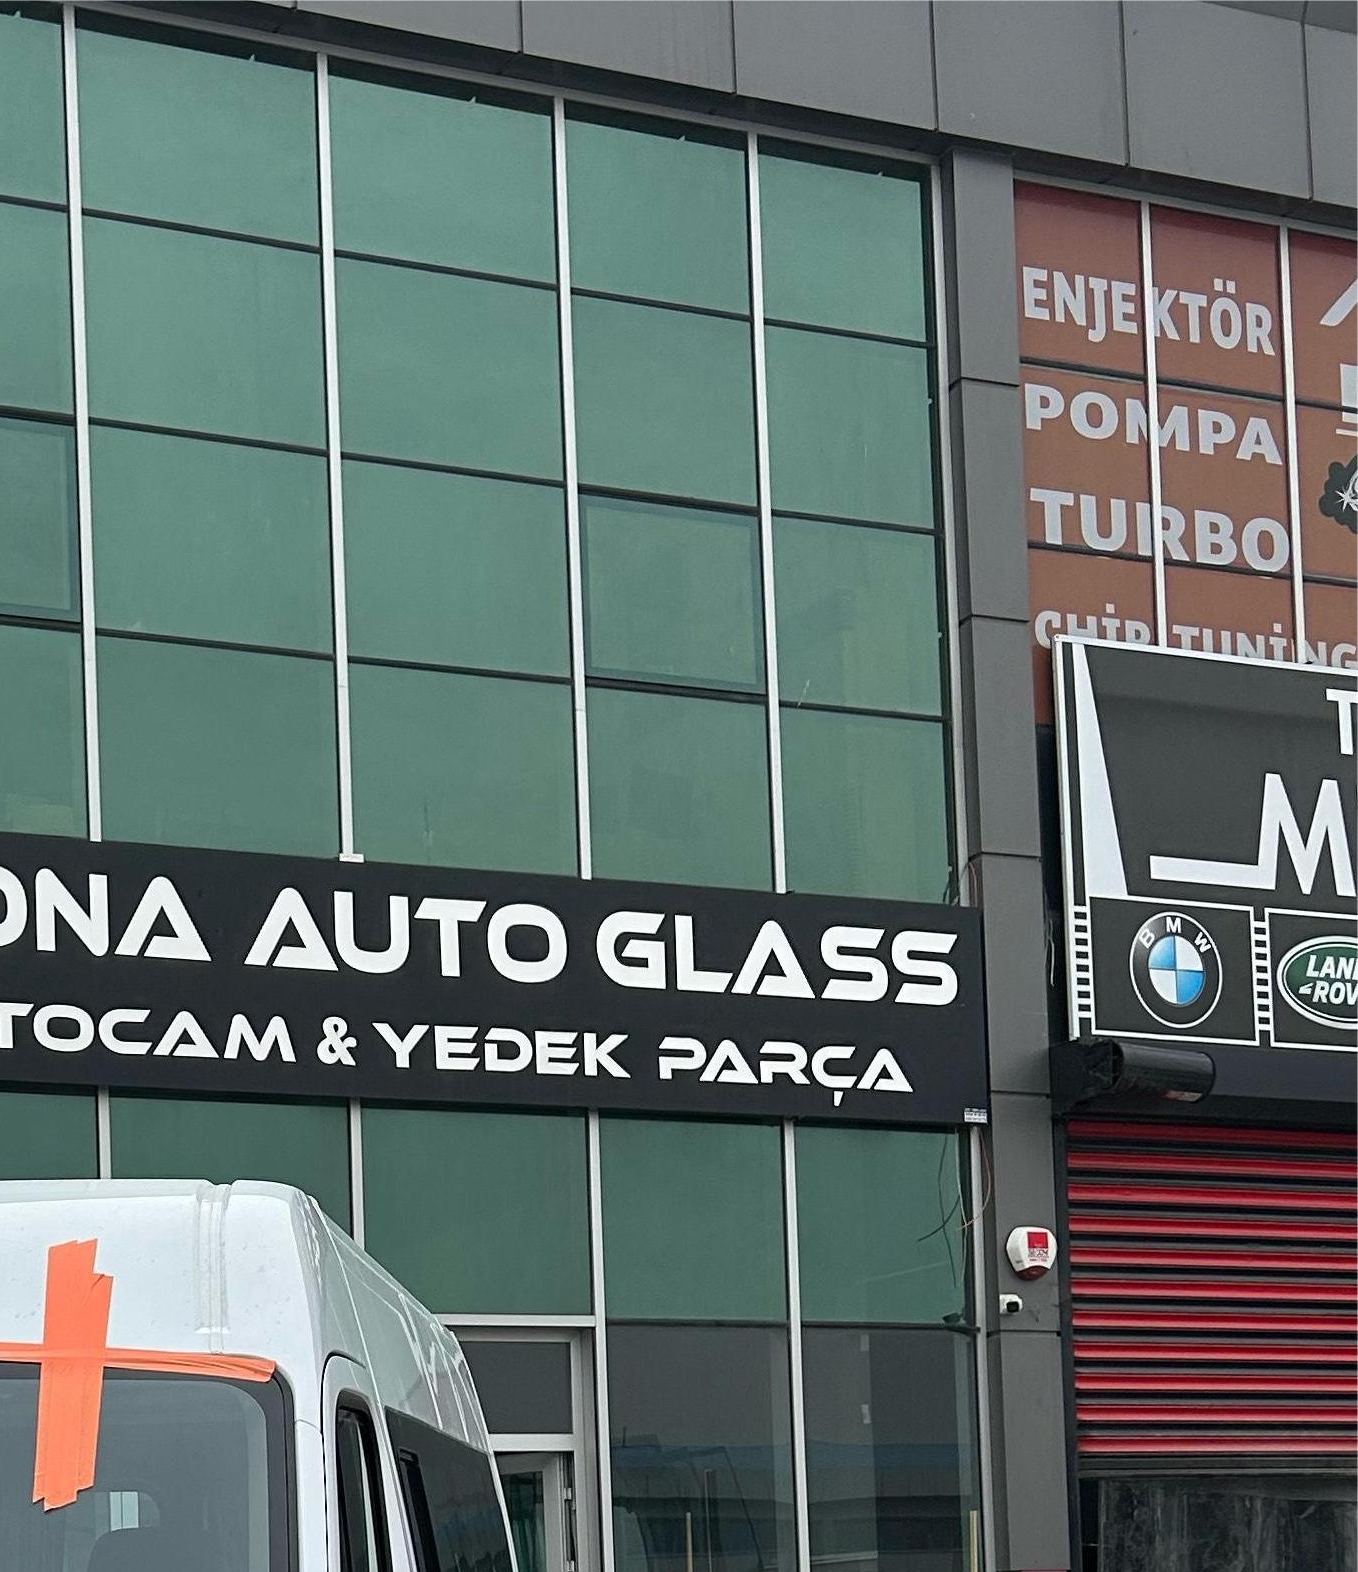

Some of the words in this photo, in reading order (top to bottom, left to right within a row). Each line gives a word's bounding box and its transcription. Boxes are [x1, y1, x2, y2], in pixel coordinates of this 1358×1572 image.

[1021, 265, 1276, 357] ENJEKTÖR
[1024, 382, 1284, 466] POMPA
[1029, 487, 1291, 574] TURBO
[243, 886, 569, 985] AUTO
[596, 910, 960, 1007] GLASS
[1138, 916, 1212, 954] BMW
[1306, 954, 1357, 980] LAN
[316, 1015, 358, 1067] &
[372, 1021, 632, 1079] YEDEK
[658, 1036, 914, 1107] PARÇA
